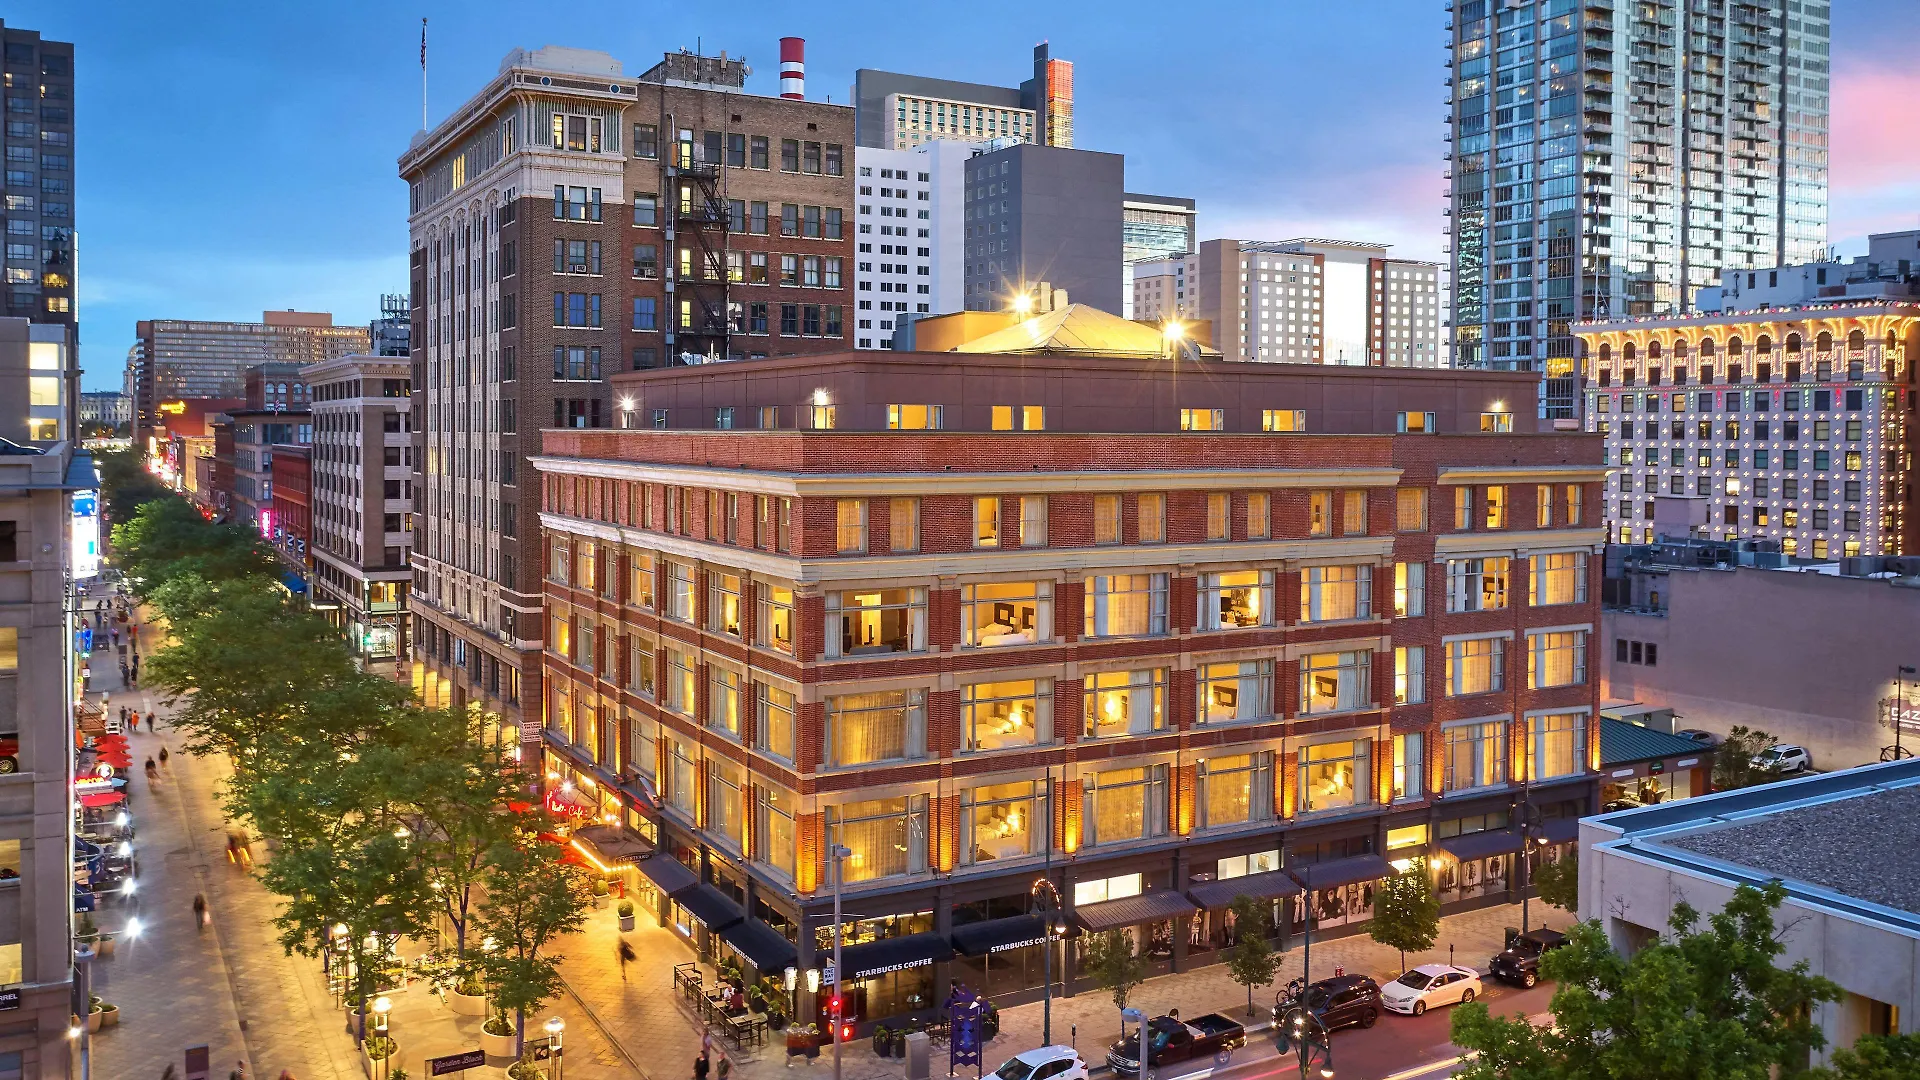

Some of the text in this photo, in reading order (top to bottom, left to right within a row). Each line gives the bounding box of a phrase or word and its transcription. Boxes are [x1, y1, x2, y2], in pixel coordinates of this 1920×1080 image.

[991, 939, 1034, 953] STARBUCKS
[856, 958, 933, 978] STARBUCKS COFFEE
